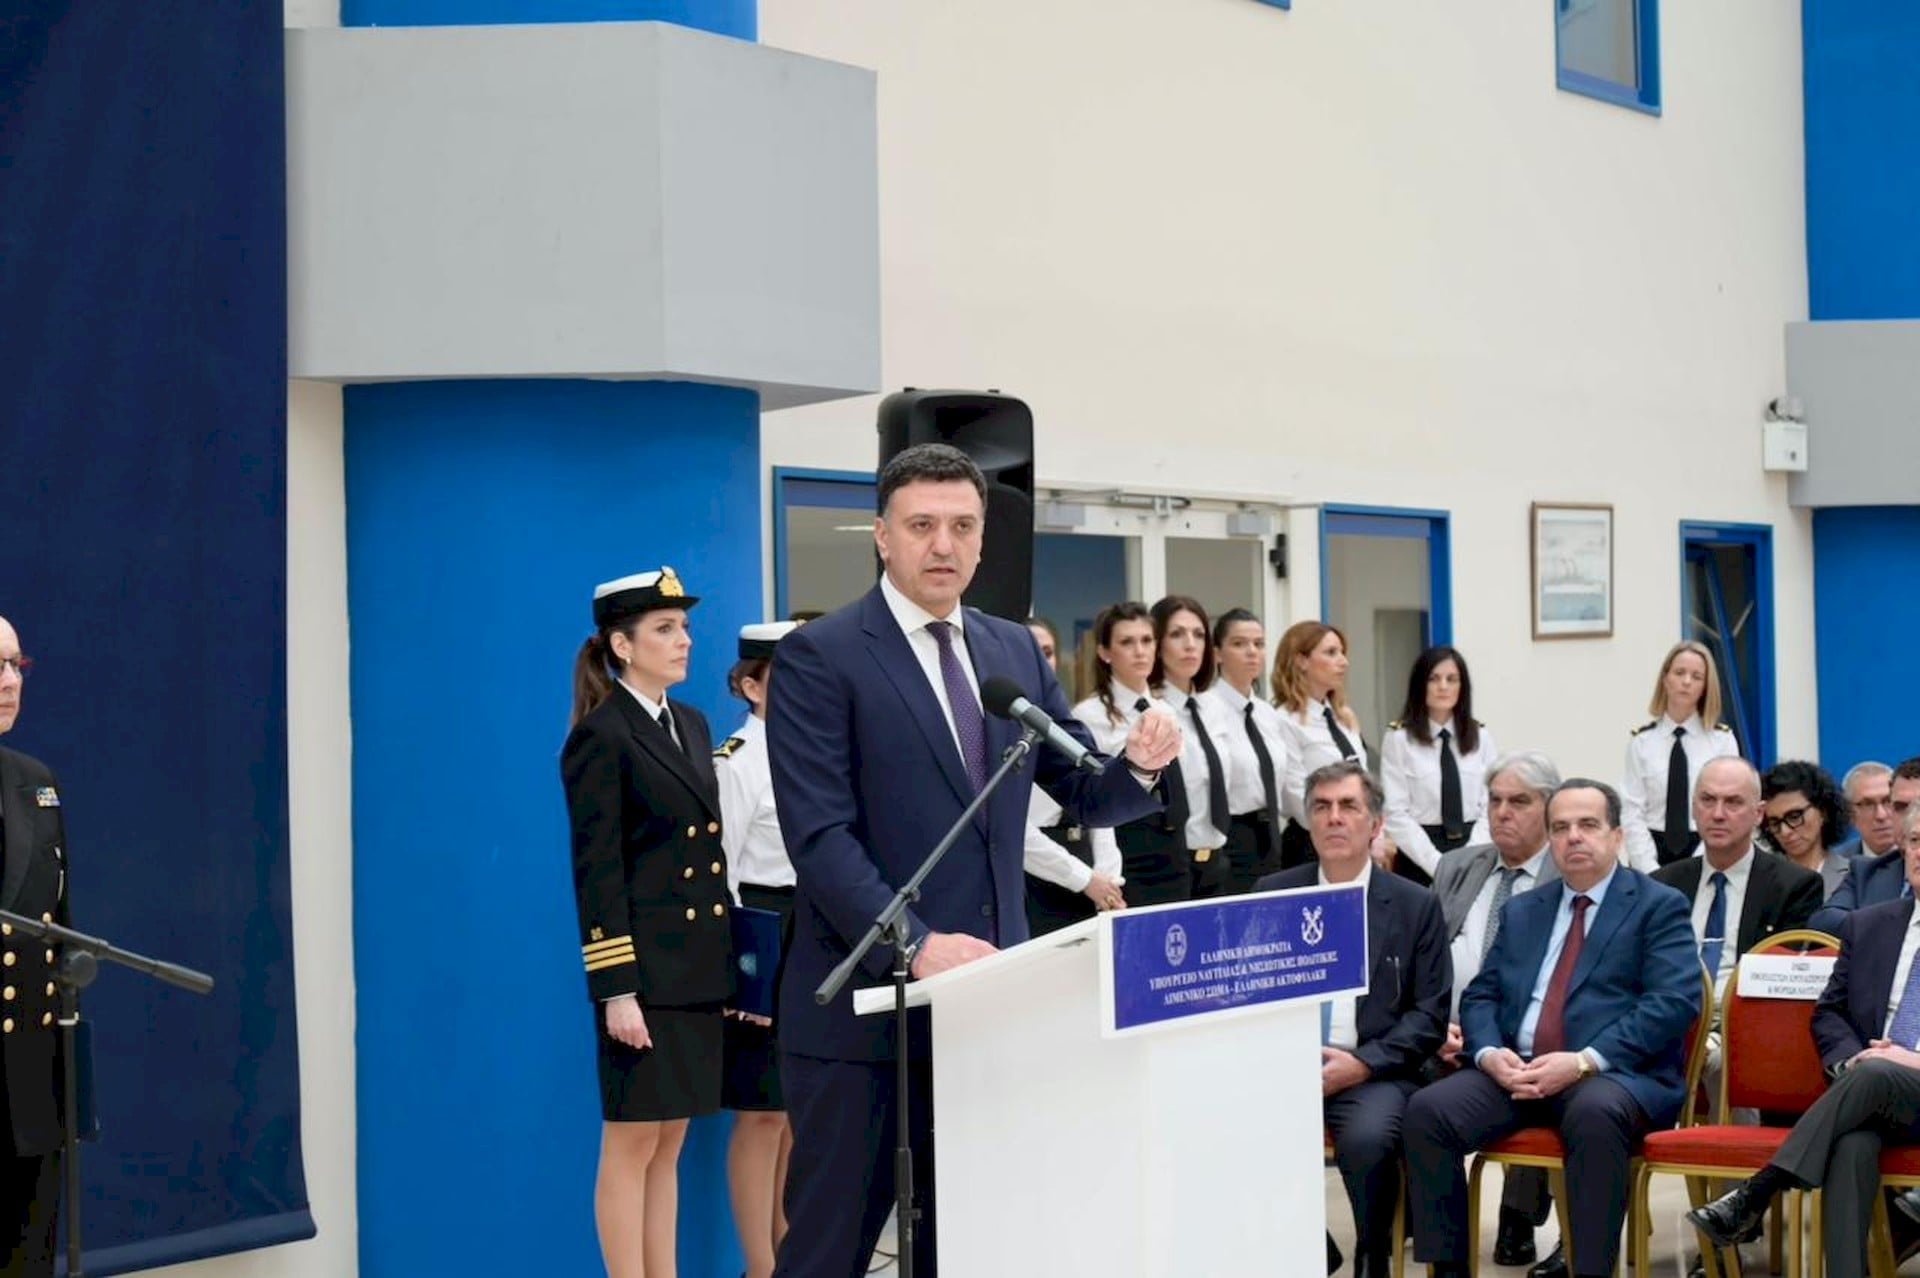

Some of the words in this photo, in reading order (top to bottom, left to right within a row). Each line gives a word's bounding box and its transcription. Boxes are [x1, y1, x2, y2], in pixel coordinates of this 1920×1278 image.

[1149, 971, 1197, 992] ΥΠΟΥΡΓΕΙΟ
[1198, 965, 1240, 981] ΝΑΥΤΙΛΙΑΣ
[1297, 950, 1338, 967] ΠΟΛΙΤΙΚΗΣ
[1200, 947, 1242, 964] ΕΛΛΗΝΙΚΗ
[1243, 941, 1292, 959] ΔΗΜΟΚΡΑΤΙΑ
[1164, 987, 1205, 1006] ΛΙΜΕΝΙΚΟ
[1205, 984, 1230, 998] ΣΩΜΑ
[1234, 976, 1275, 994] ΕΛΛΗΝΙΚΗ
[1276, 968, 1327, 986] ΑΚΤΟΦΥΛΑΚΗ
